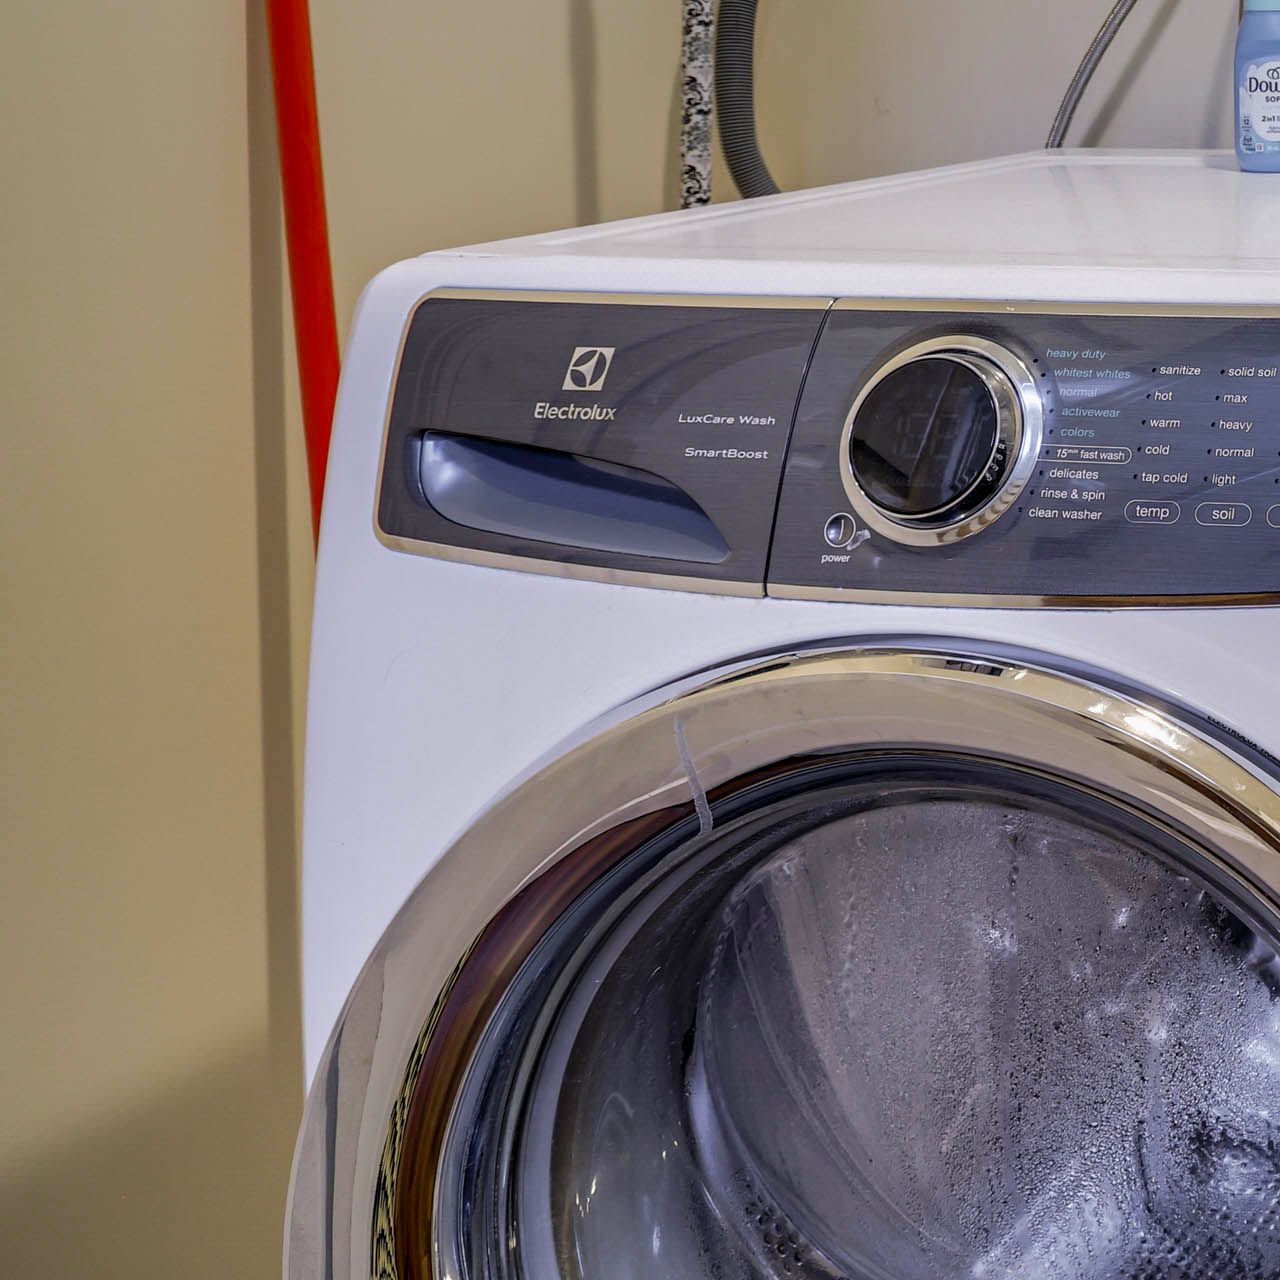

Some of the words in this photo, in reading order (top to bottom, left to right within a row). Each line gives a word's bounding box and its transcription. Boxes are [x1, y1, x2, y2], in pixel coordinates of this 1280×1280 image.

[1046, 348, 1079, 360] heavy
[1081, 349, 1106, 361] duty
[1054, 367, 1093, 379] whitest
[1096, 369, 1131, 380] whites
[1159, 365, 1201, 376] sanitize
[1228, 366, 1255, 377] solid
[1257, 367, 1277, 377] soil
[1059, 387, 1098, 397] normal
[1154, 390, 1173, 401] hot
[1223, 394, 1248, 403] max
[534, 402, 617, 420] Electrolux
[1061, 407, 1121, 418] activewear
[678, 413, 735, 424] LuxCare
[739, 415, 776, 425] Wash
[1150, 419, 1181, 428] warm
[1219, 419, 1253, 433] heavy
[1060, 427, 1095, 438] colors
[684, 447, 769, 459] SmartBoost
[1080, 449, 1098, 459] fast
[1099, 450, 1125, 461] wash
[1145, 444, 1170, 455] cold
[1215, 447, 1255, 458] normal
[1049, 467, 1099, 480] delicates
[1142, 471, 1160, 484] tap
[1163, 472, 1188, 483] cold
[1212, 473, 1236, 487] light
[1040, 487, 1068, 499] rinse
[1070, 488, 1079, 499] &
[1081, 489, 1105, 502] spin
[1028, 506, 1059, 518] clean
[1062, 509, 1103, 520] washer
[1135, 504, 1170, 520] temp
[1212, 507, 1235, 520] soil
[821, 554, 851, 564] power
